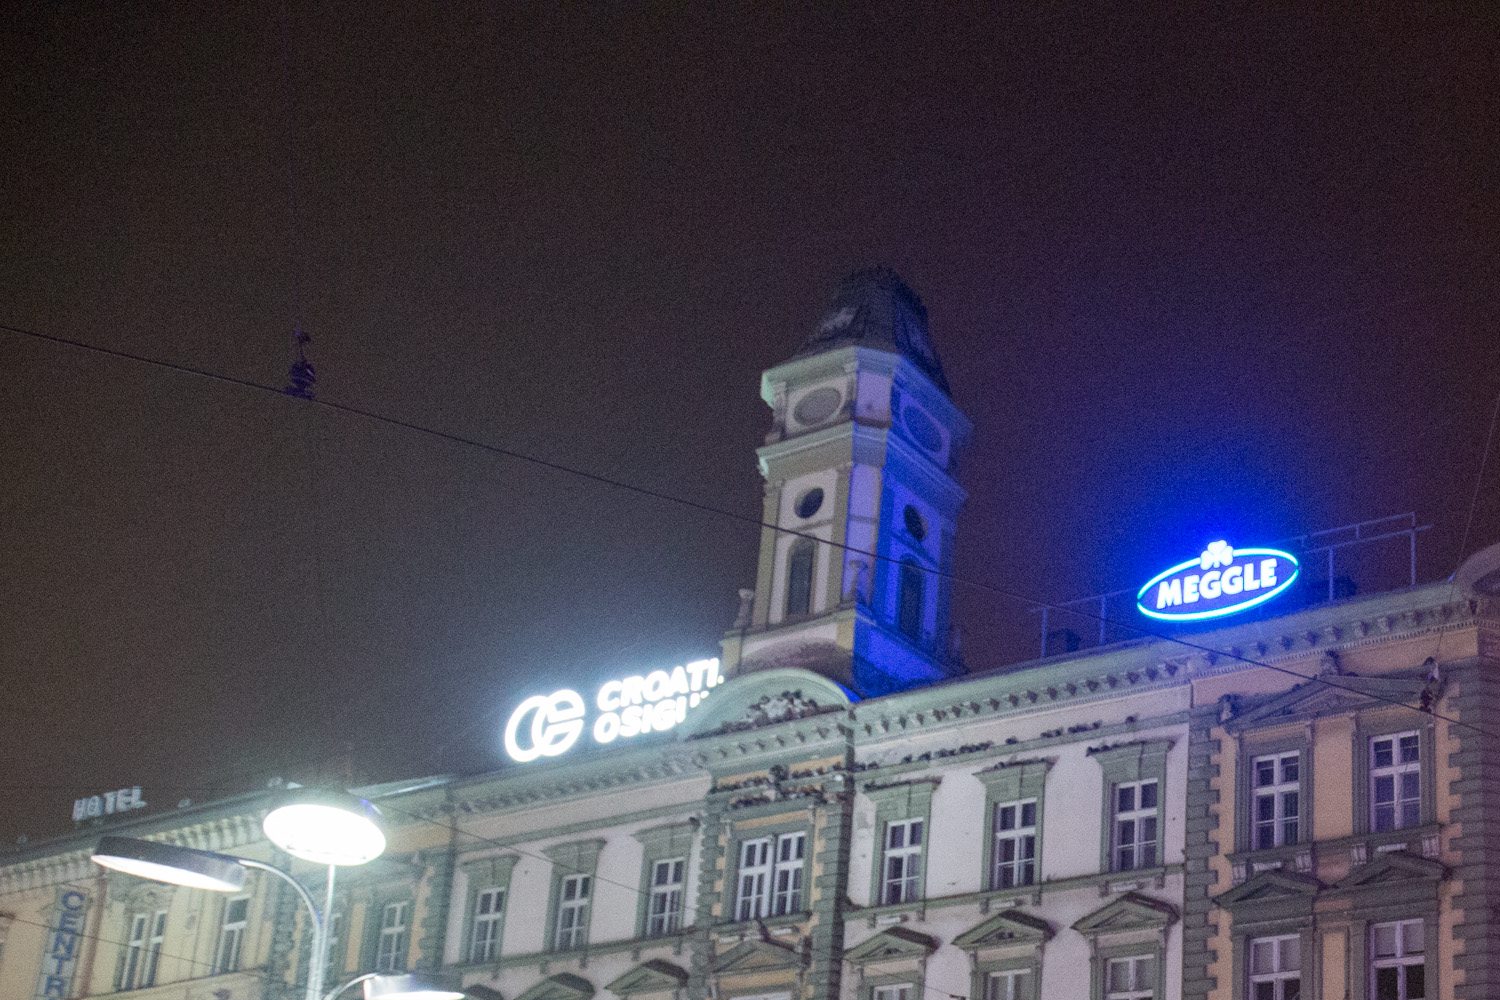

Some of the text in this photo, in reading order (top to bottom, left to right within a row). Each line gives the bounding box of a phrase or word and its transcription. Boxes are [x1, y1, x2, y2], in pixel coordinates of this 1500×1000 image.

[1156, 558, 1278, 610] MEGGLE
[597, 657, 724, 711] CROATI
[72, 785, 147, 821] HOTEL
